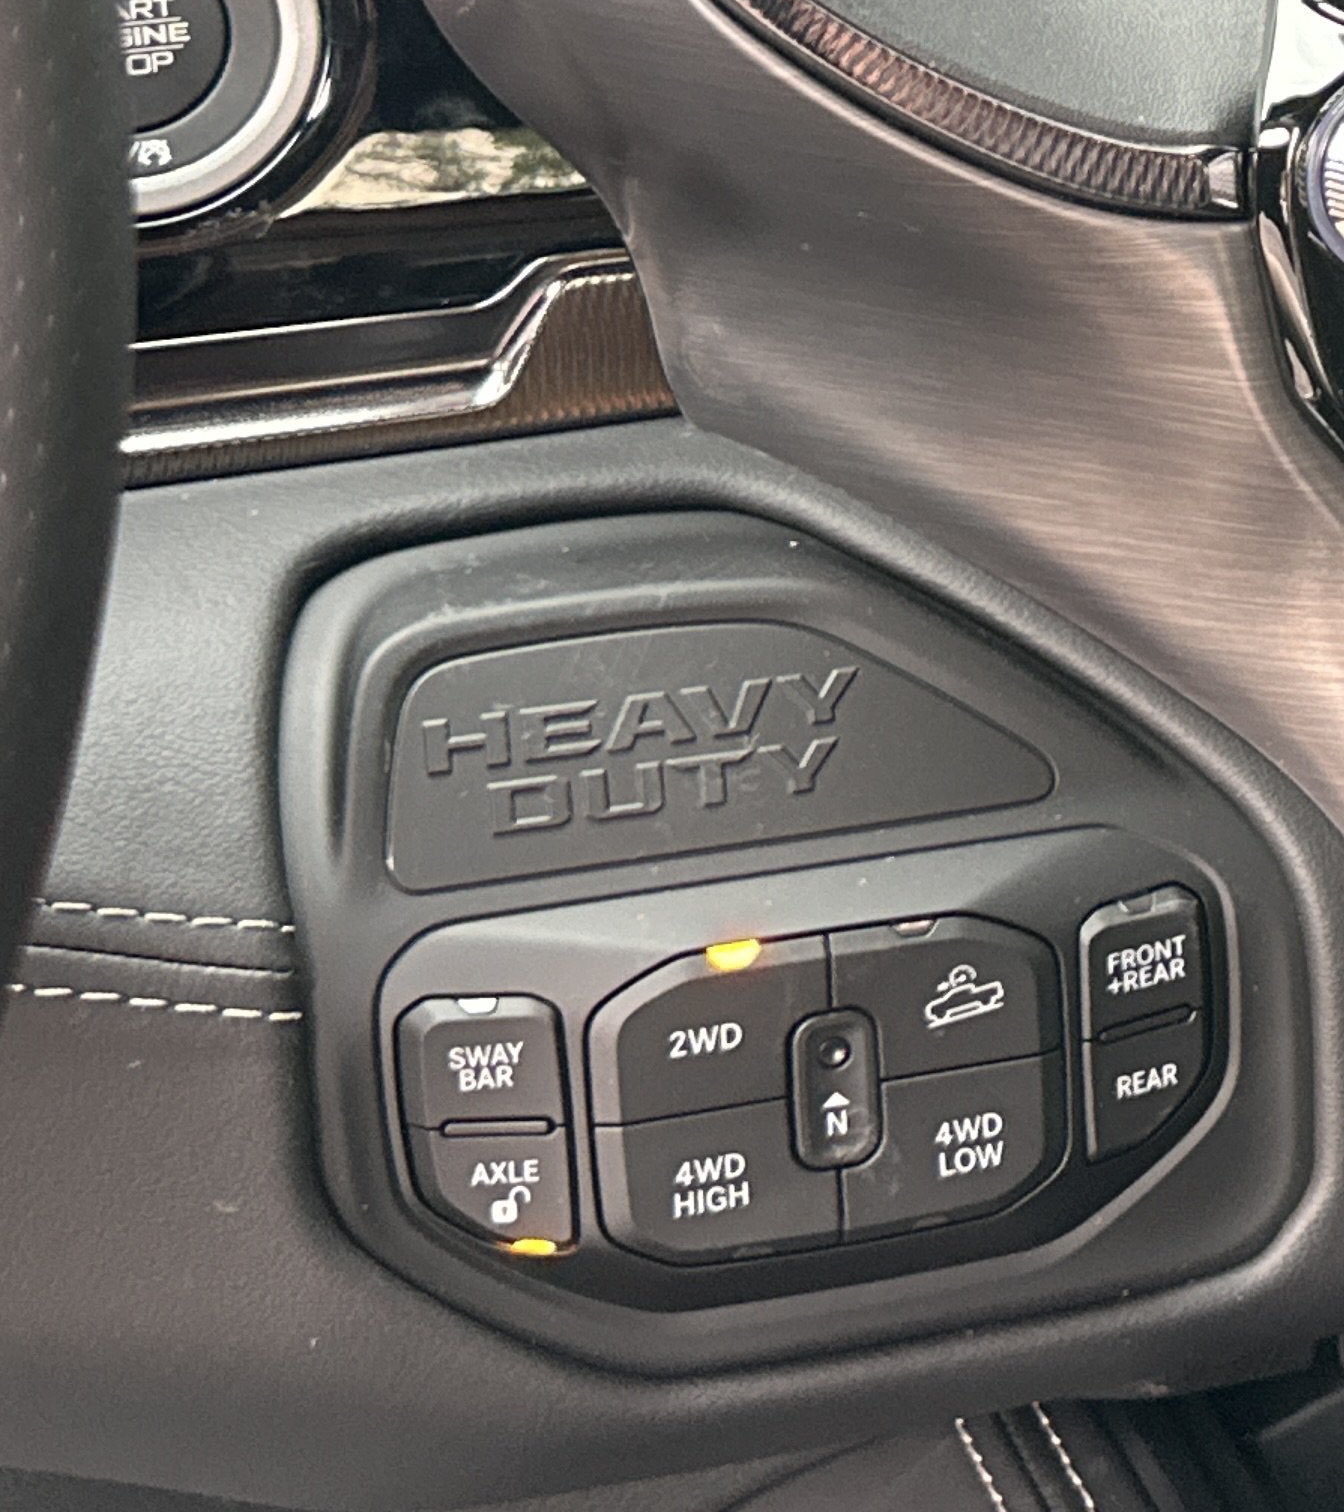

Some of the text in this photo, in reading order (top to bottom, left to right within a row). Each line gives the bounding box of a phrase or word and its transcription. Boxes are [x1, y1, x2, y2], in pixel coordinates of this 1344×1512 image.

[125, 50, 175, 76] OP
[422, 666, 860, 774] HEAVY
[486, 736, 838, 837] DUTY
[1106, 934, 1187, 976] FRONT
[448, 1042, 524, 1071] SWAY
[668, 1022, 744, 1059] 2WD
[458, 1066, 514, 1092] BAR
[1115, 1063, 1179, 1100] REAR
[935, 1112, 1004, 1148] 4WD
[470, 1159, 540, 1187] AXLE
[675, 1153, 747, 1187] 4WD
[938, 1141, 1004, 1178] LOW
[672, 1181, 751, 1220] HIGH
